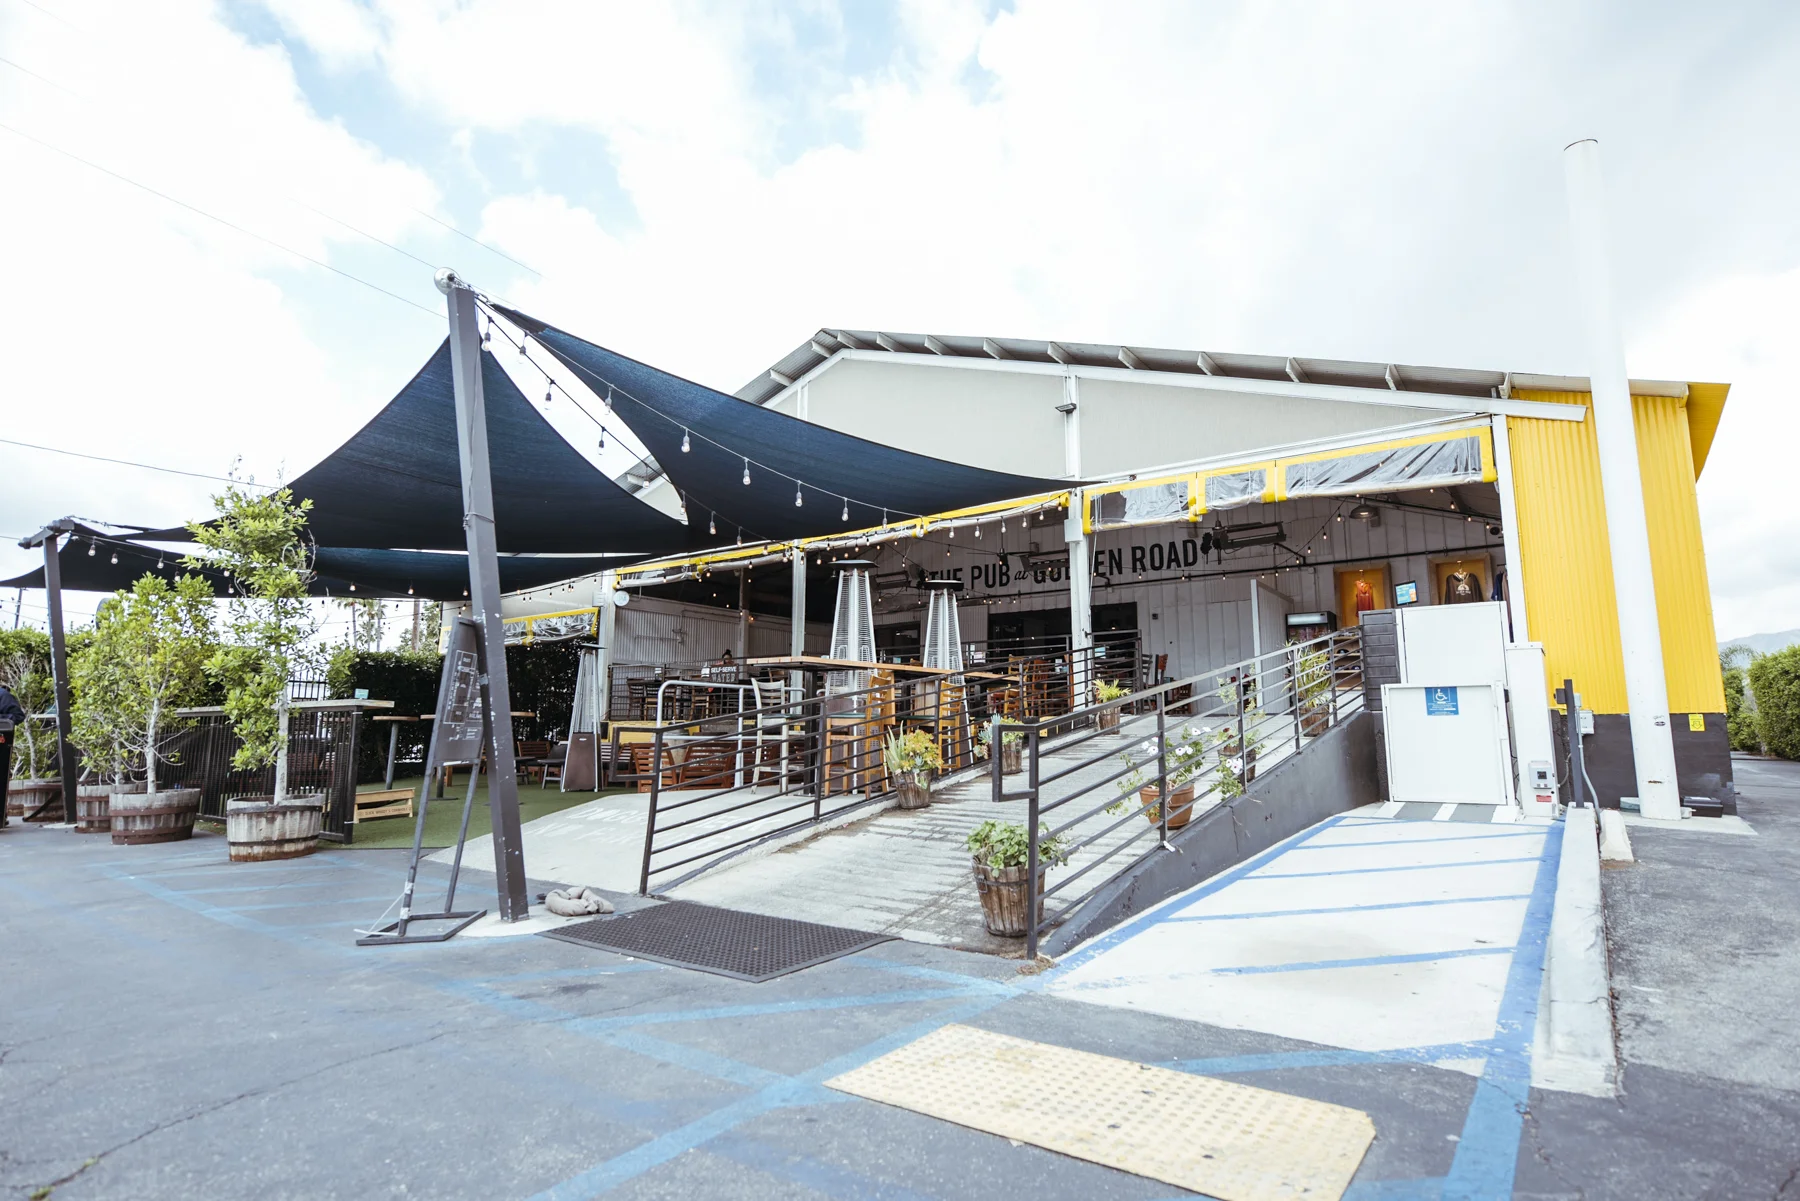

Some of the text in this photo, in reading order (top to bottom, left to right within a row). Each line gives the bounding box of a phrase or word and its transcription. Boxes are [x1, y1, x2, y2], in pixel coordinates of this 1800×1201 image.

[971, 561, 1010, 589] PUB
[1033, 548, 1123, 584] GOEN
[1131, 539, 1198, 573] ROAD
[712, 673, 736, 682] WATER
